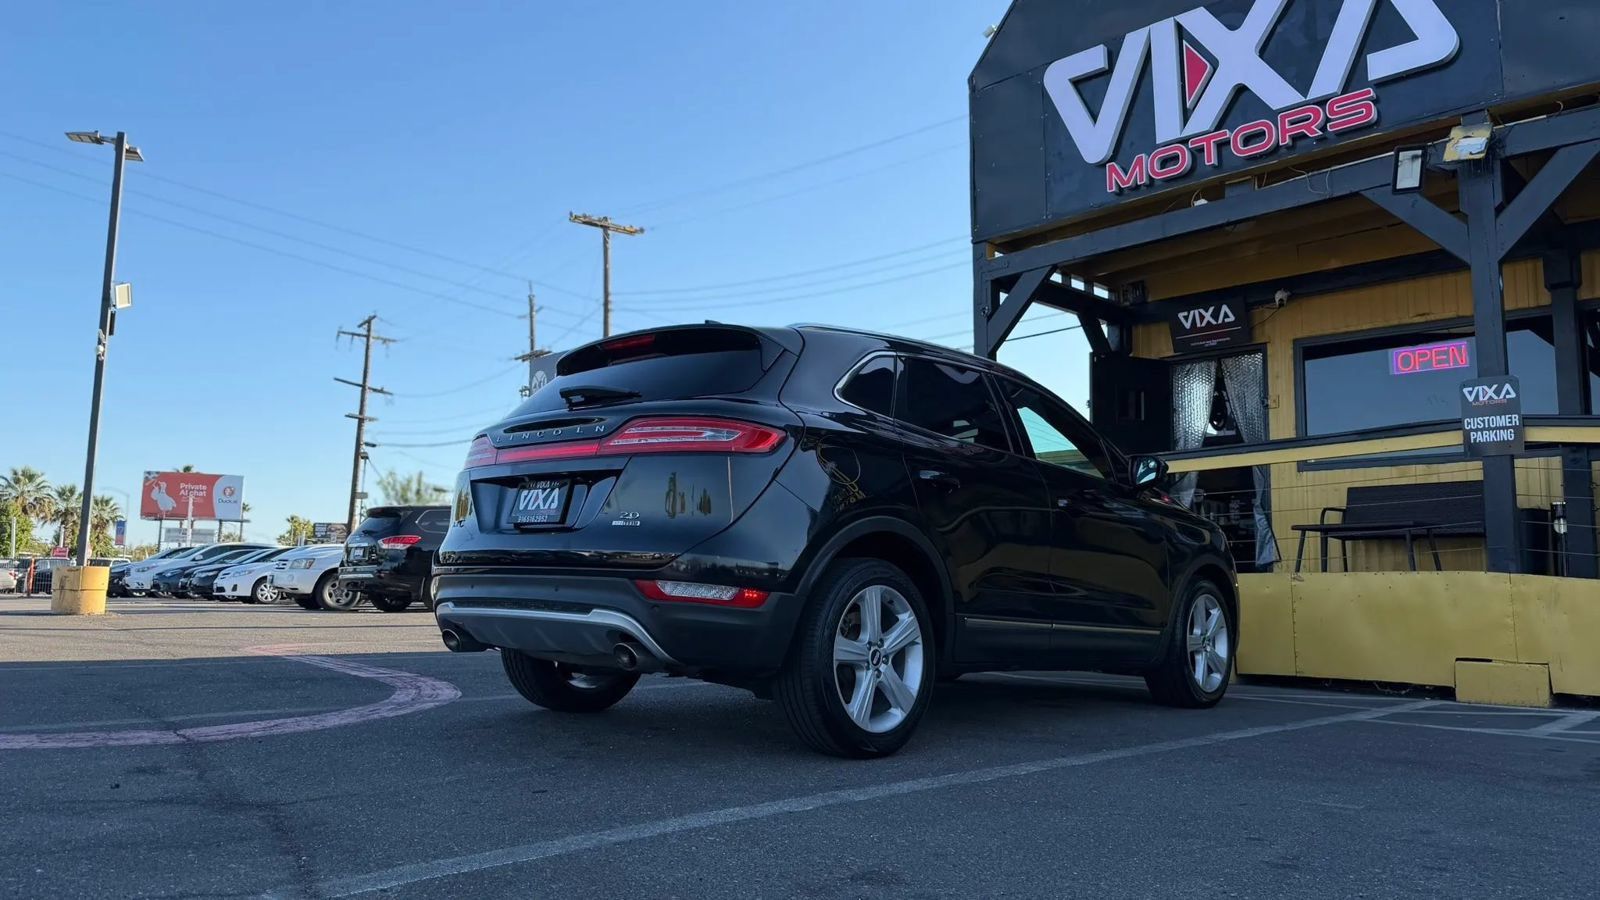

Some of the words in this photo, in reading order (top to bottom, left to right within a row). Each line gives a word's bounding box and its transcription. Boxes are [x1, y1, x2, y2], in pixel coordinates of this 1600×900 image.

[1043, 0, 1459, 164] VIXA
[1106, 87, 1378, 193] MOTORS
[1177, 304, 1236, 330] VIXA
[1397, 344, 1466, 371] OPEN
[1462, 383, 1516, 402] VIXA
[1464, 414, 1519, 430] CUSTOMER
[497, 425, 604, 442] LINCOLN
[1470, 428, 1514, 443] PARKING
[180, 483, 207, 491] Private
[519, 488, 559, 510] VIXA
